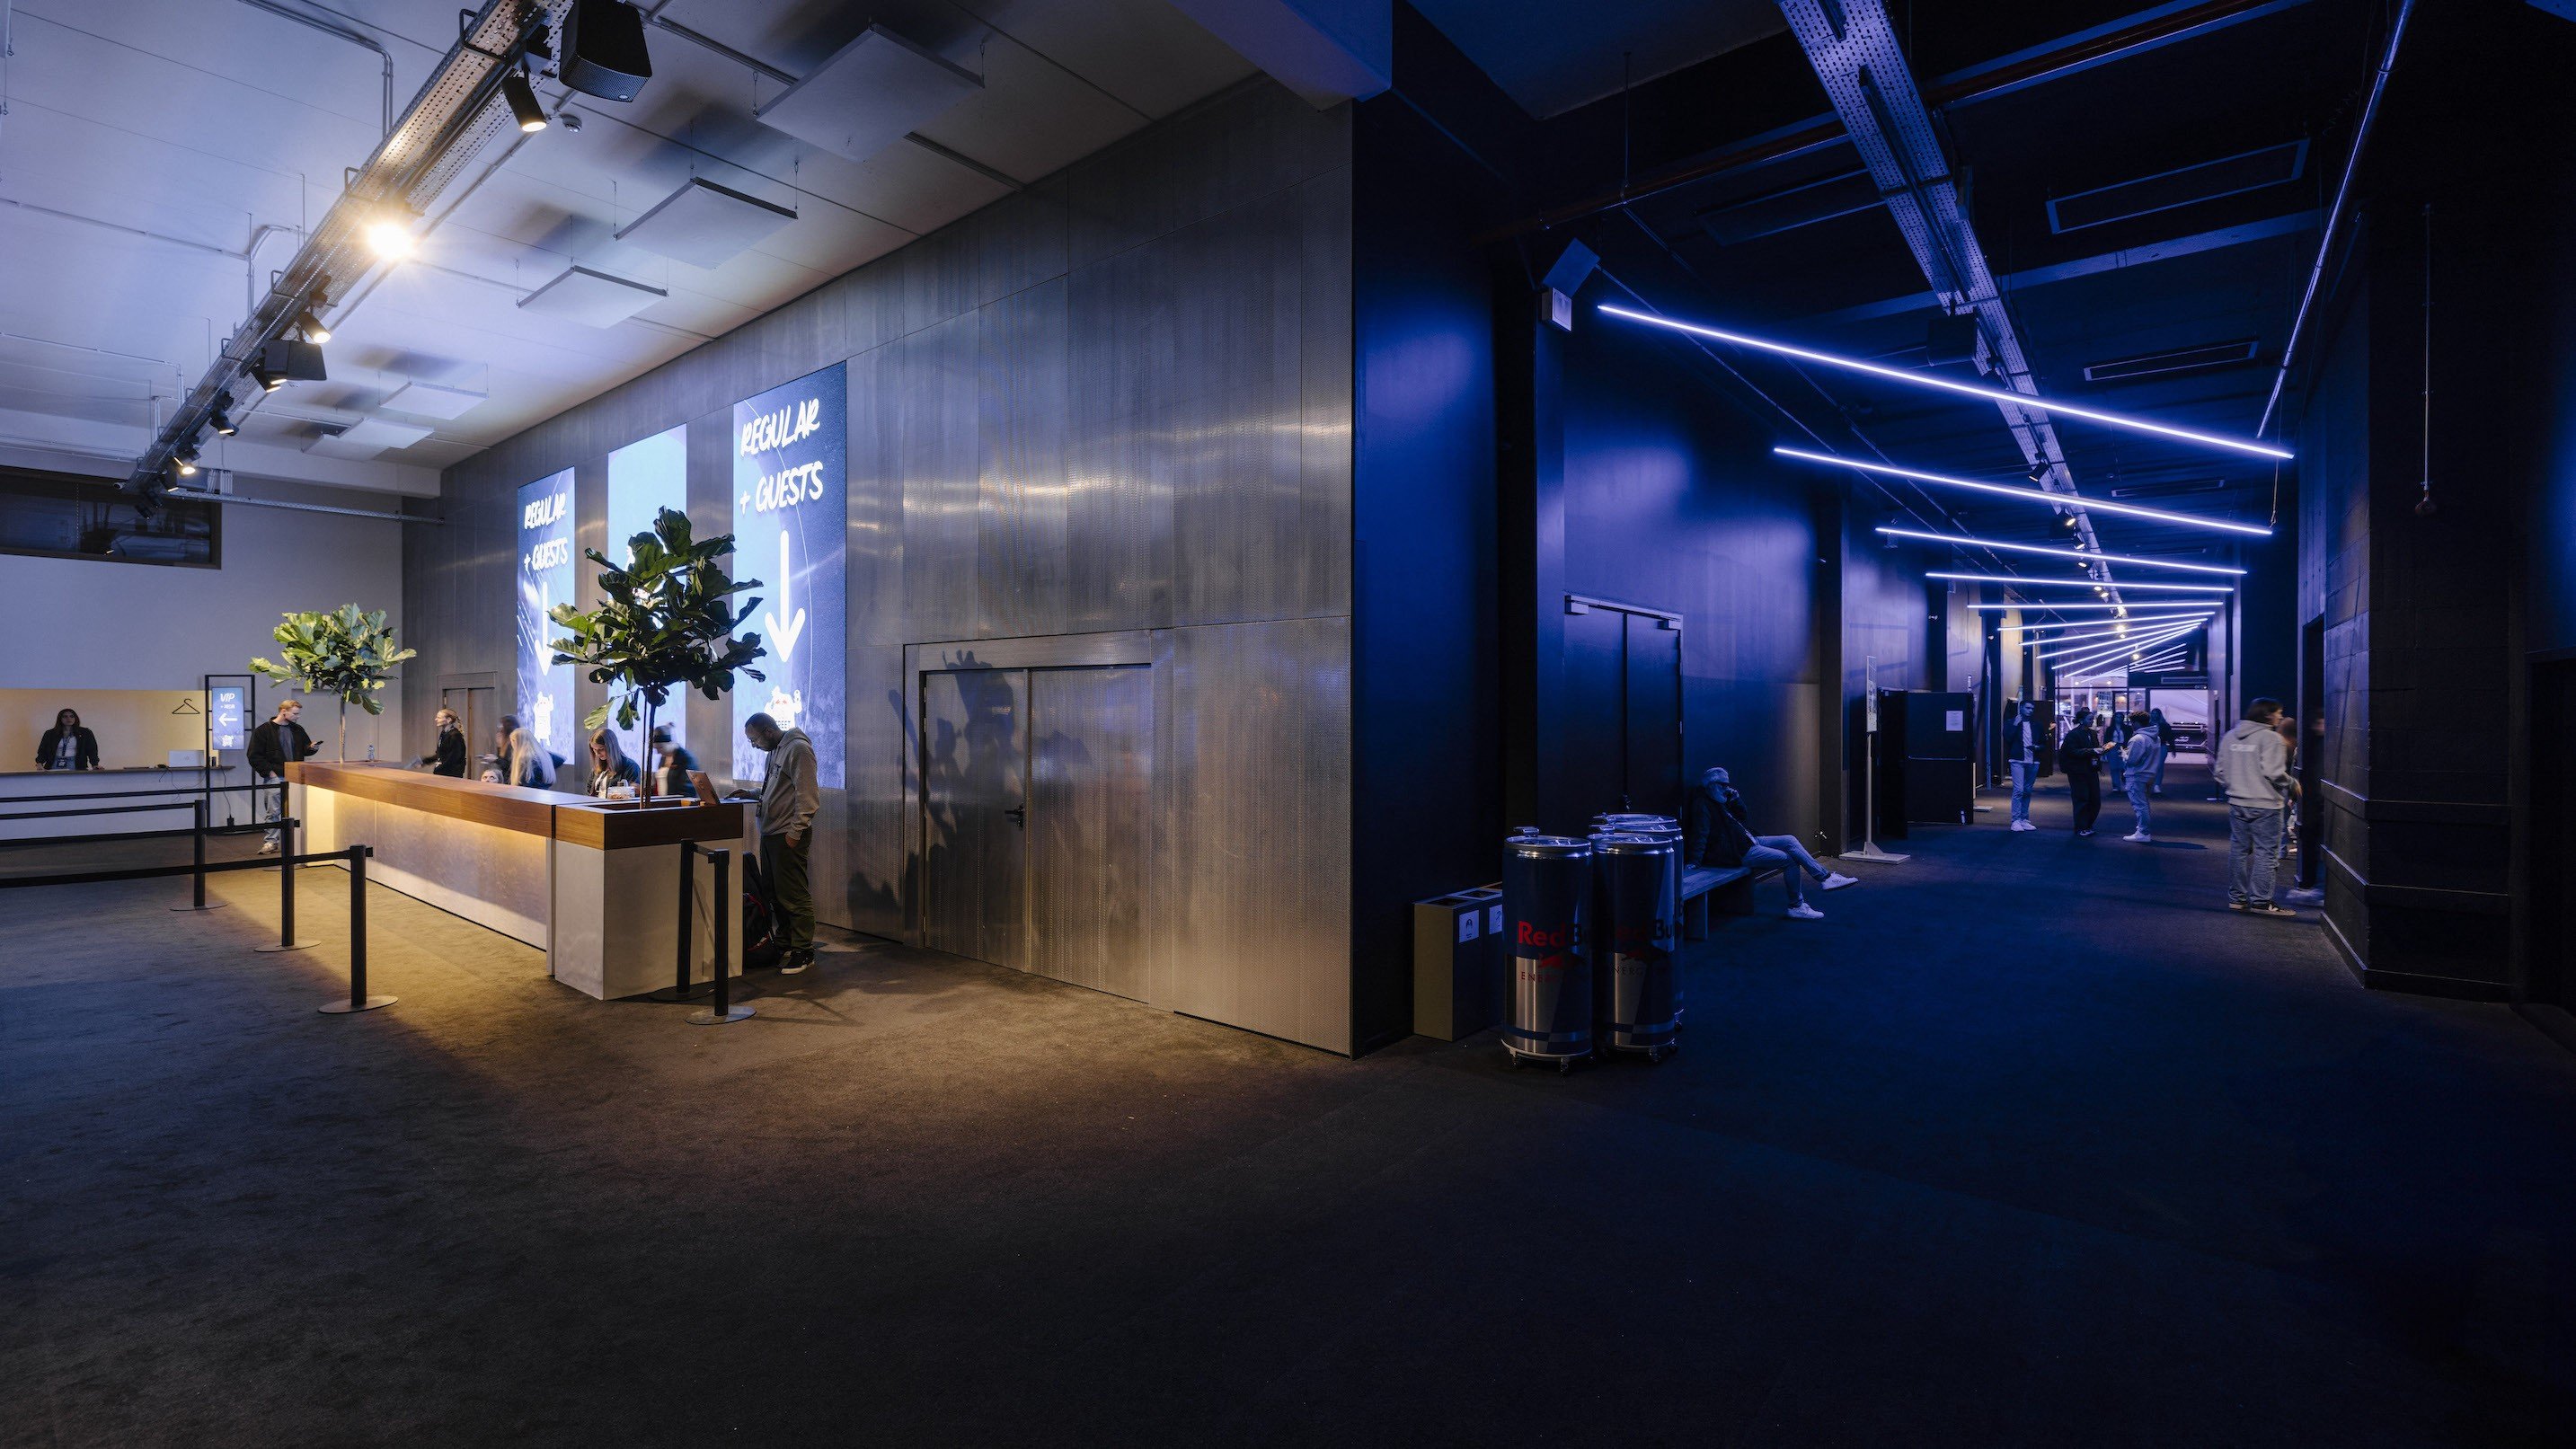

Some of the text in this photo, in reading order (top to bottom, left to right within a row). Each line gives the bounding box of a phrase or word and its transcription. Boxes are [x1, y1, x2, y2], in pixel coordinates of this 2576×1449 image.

[739, 398, 820, 457] REGULAR
[755, 460, 824, 513] GUESTS
[524, 492, 567, 530] REGULAR
[531, 537, 568, 571] GUESTS
[220, 693, 235, 702] VIP
[1518, 920, 1566, 949] Red
